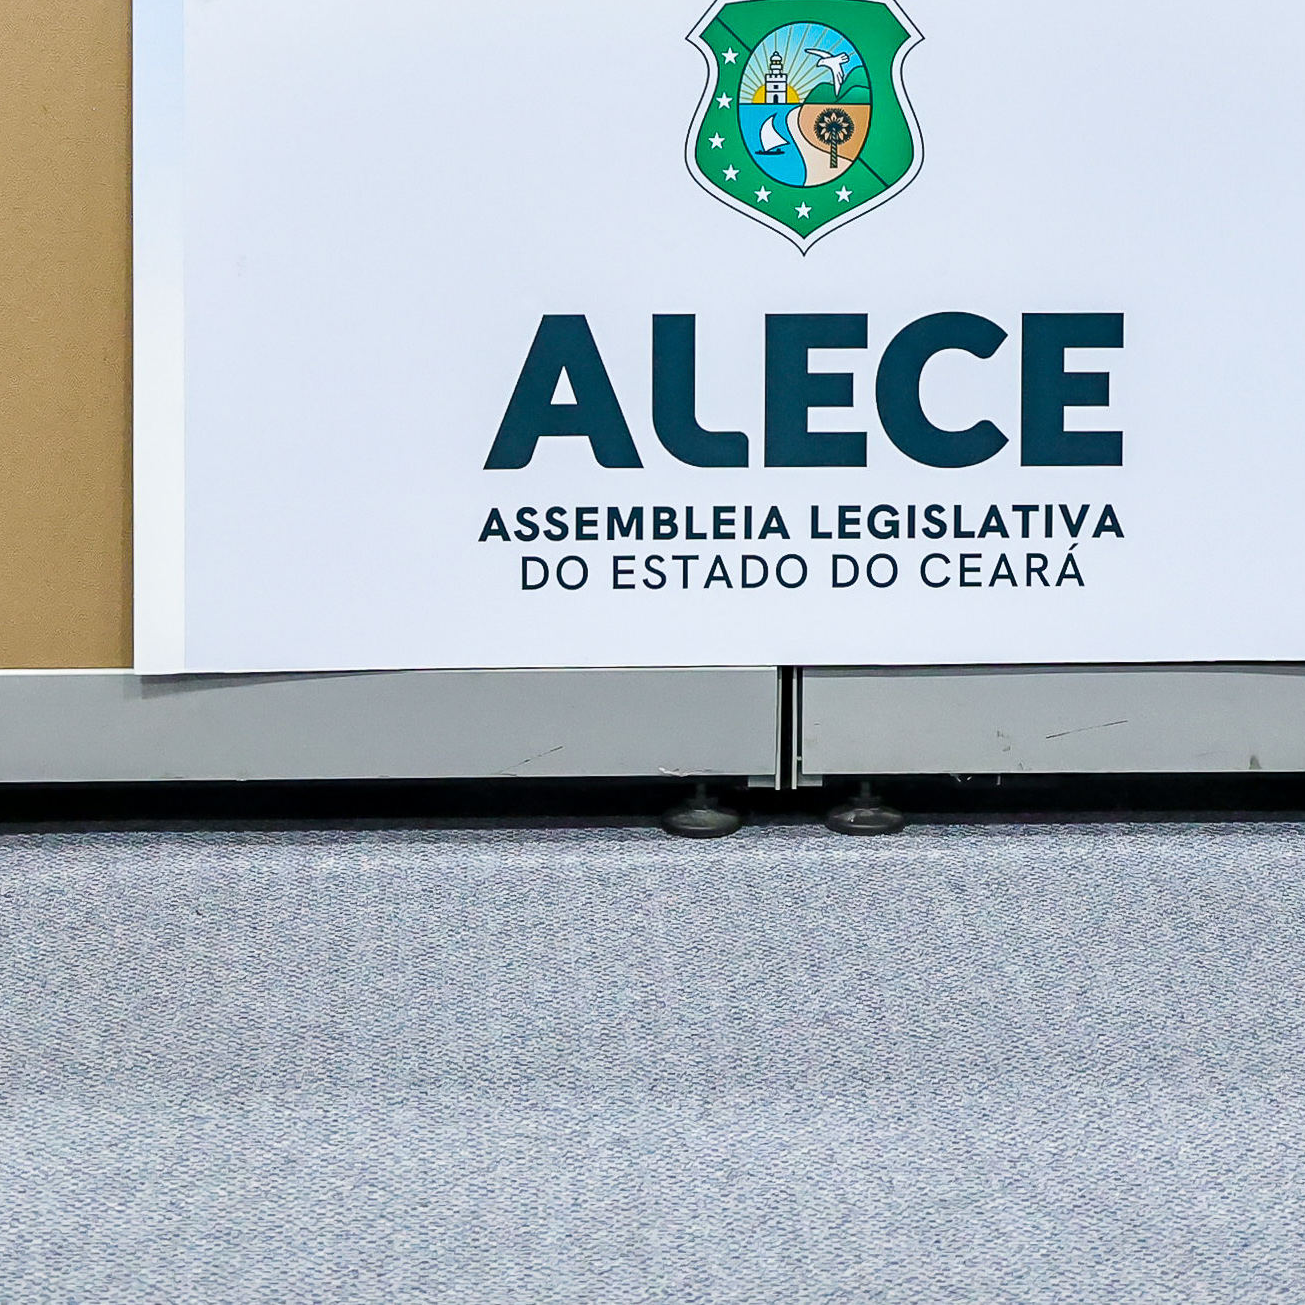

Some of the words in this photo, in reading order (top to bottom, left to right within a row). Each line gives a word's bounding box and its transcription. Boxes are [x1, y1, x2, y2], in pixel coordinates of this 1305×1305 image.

[482, 311, 1125, 471] ALECE
[477, 505, 791, 543] ASSEMBLEIA
[810, 503, 1125, 540] LEGISLATIVA
[521, 555, 589, 591] DO
[612, 553, 808, 590] ESTADO
[831, 552, 899, 589] DO
[920, 542, 1085, 589] CEARÁ
